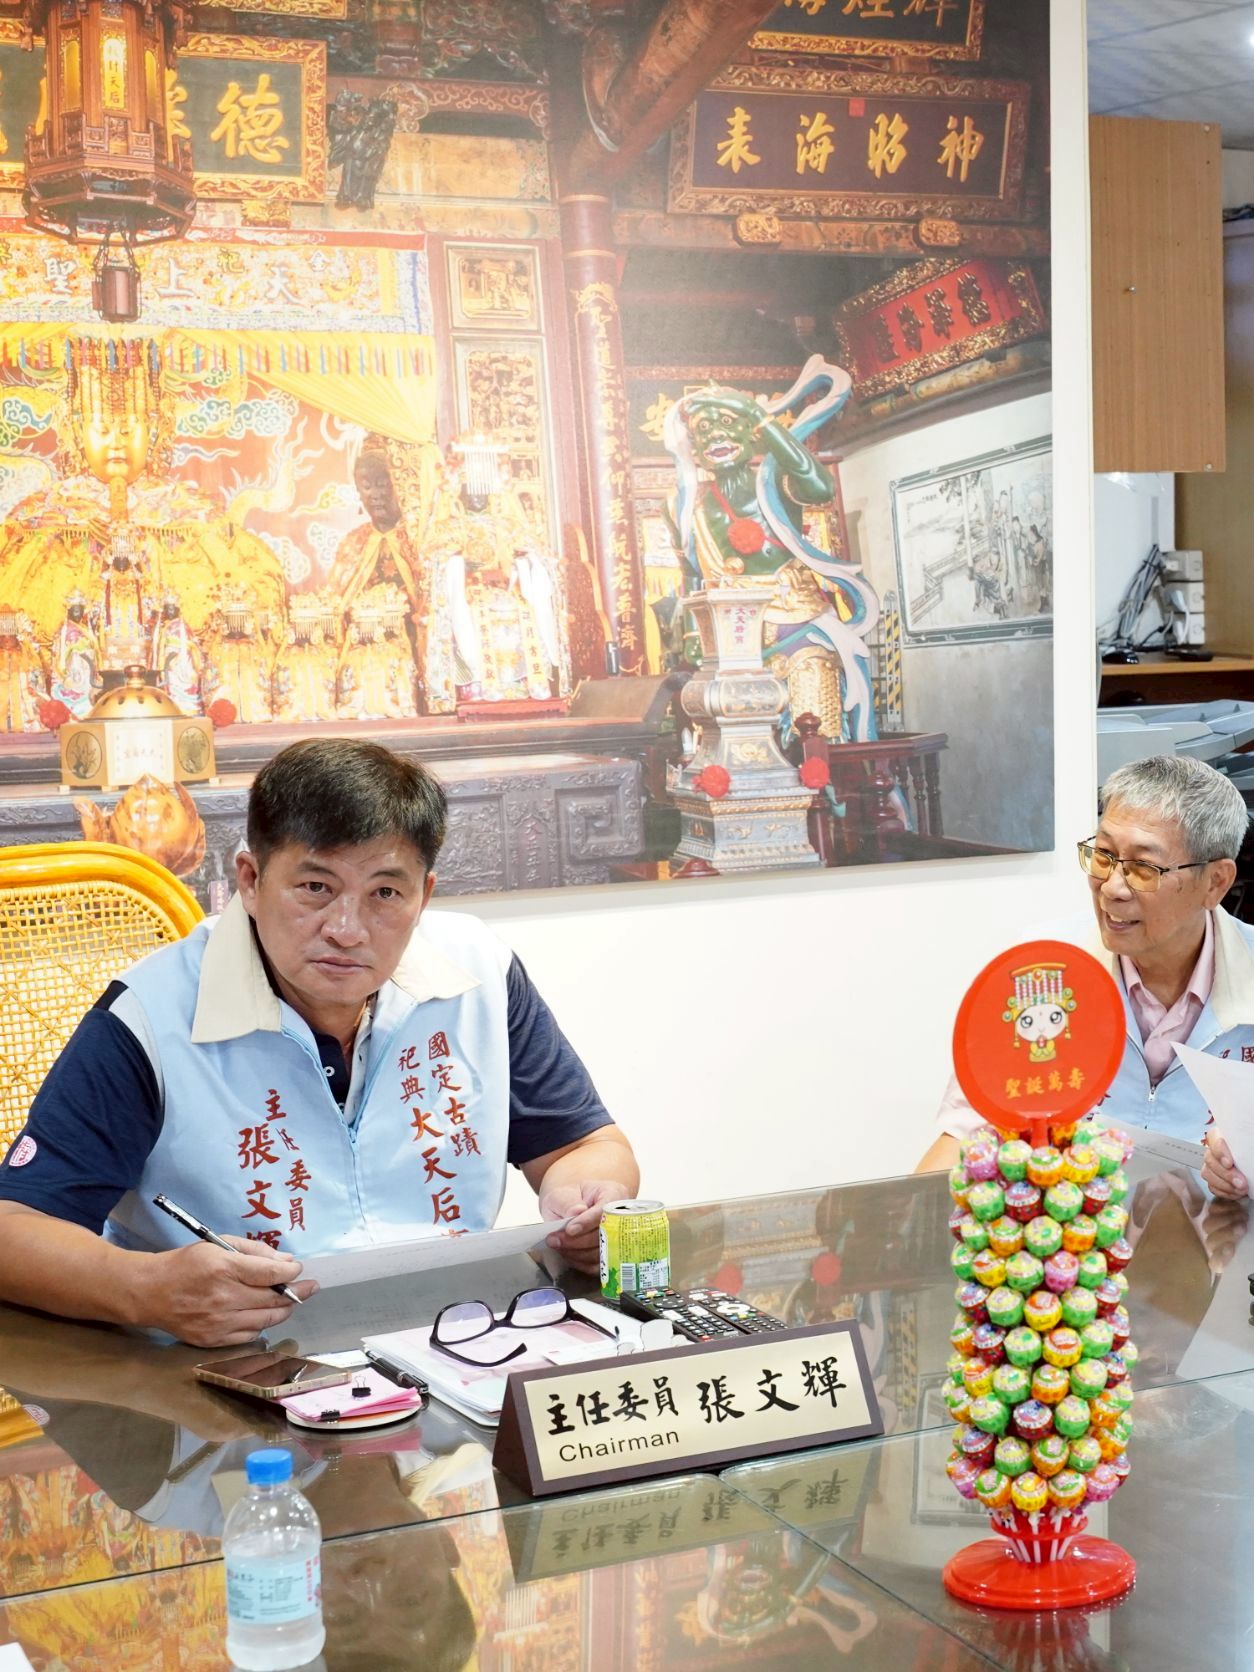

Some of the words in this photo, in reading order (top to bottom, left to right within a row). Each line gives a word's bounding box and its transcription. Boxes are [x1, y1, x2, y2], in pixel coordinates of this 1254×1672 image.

[428, 1031, 483, 1158] 國定古蹟
[264, 1088, 312, 1232] 主任委員
[546, 1374, 680, 1436] 主任委員
[695, 1355, 848, 1424] 張文輝
[558, 1428, 681, 1463] Chairman
